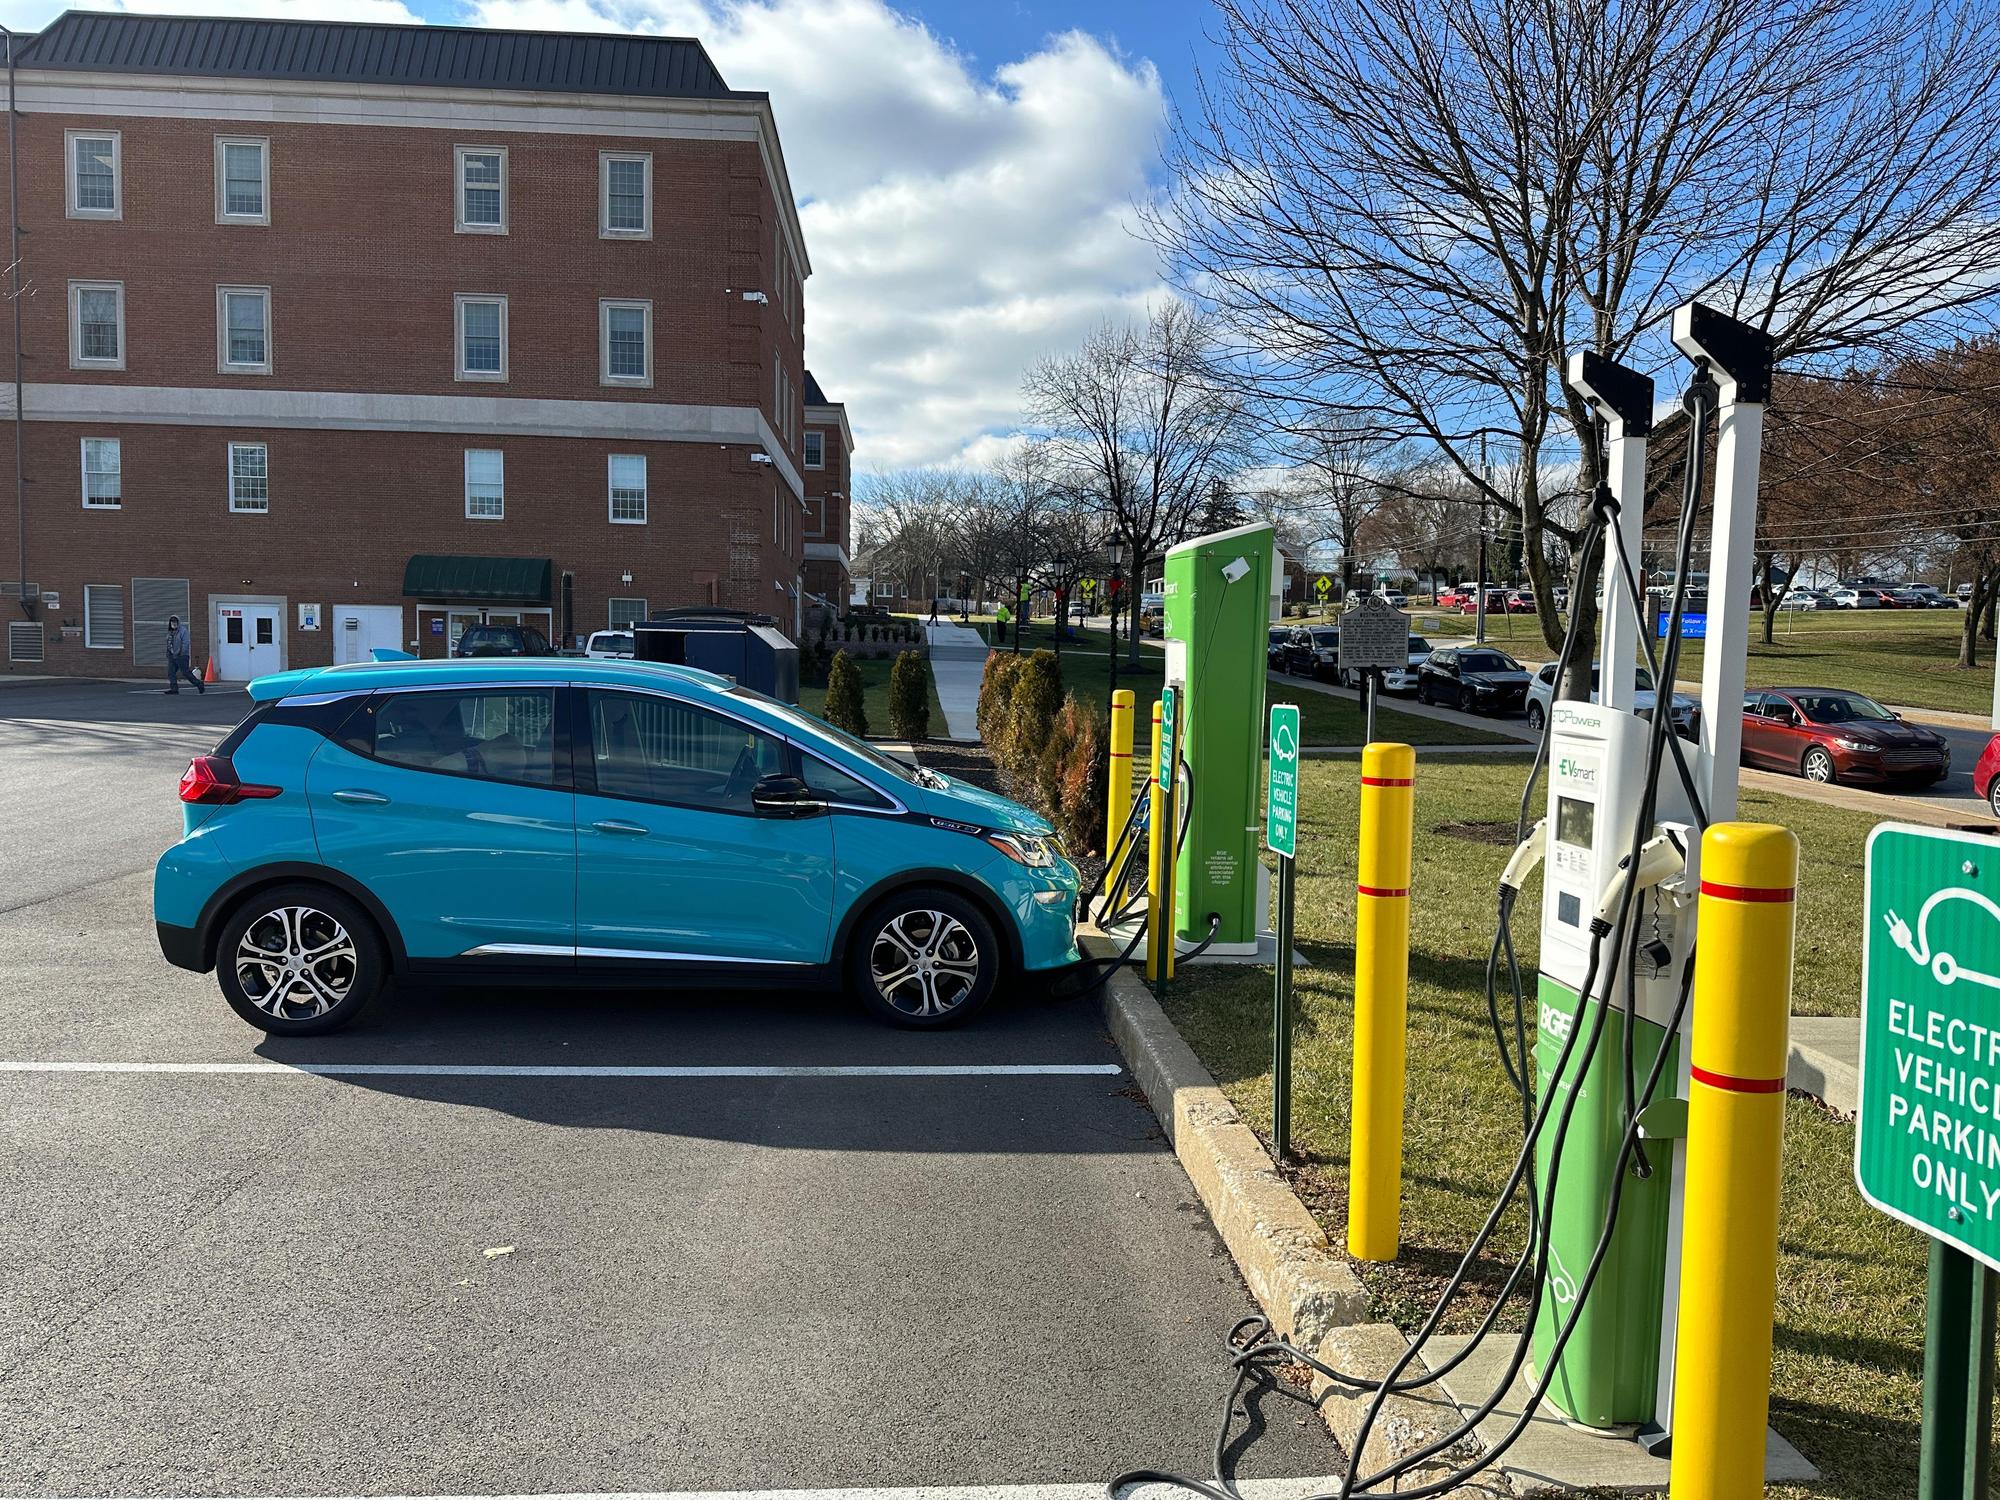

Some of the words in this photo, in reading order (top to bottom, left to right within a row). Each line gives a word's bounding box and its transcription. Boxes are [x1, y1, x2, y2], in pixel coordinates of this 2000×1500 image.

[1272, 769, 1294, 787] ELECTRIC
[1273, 787, 1292, 805] VEHICLE
[1272, 804, 1292, 823] PARKING
[1275, 823, 1288, 839] ONLY
[1912, 1153, 2000, 1221] ONLY
